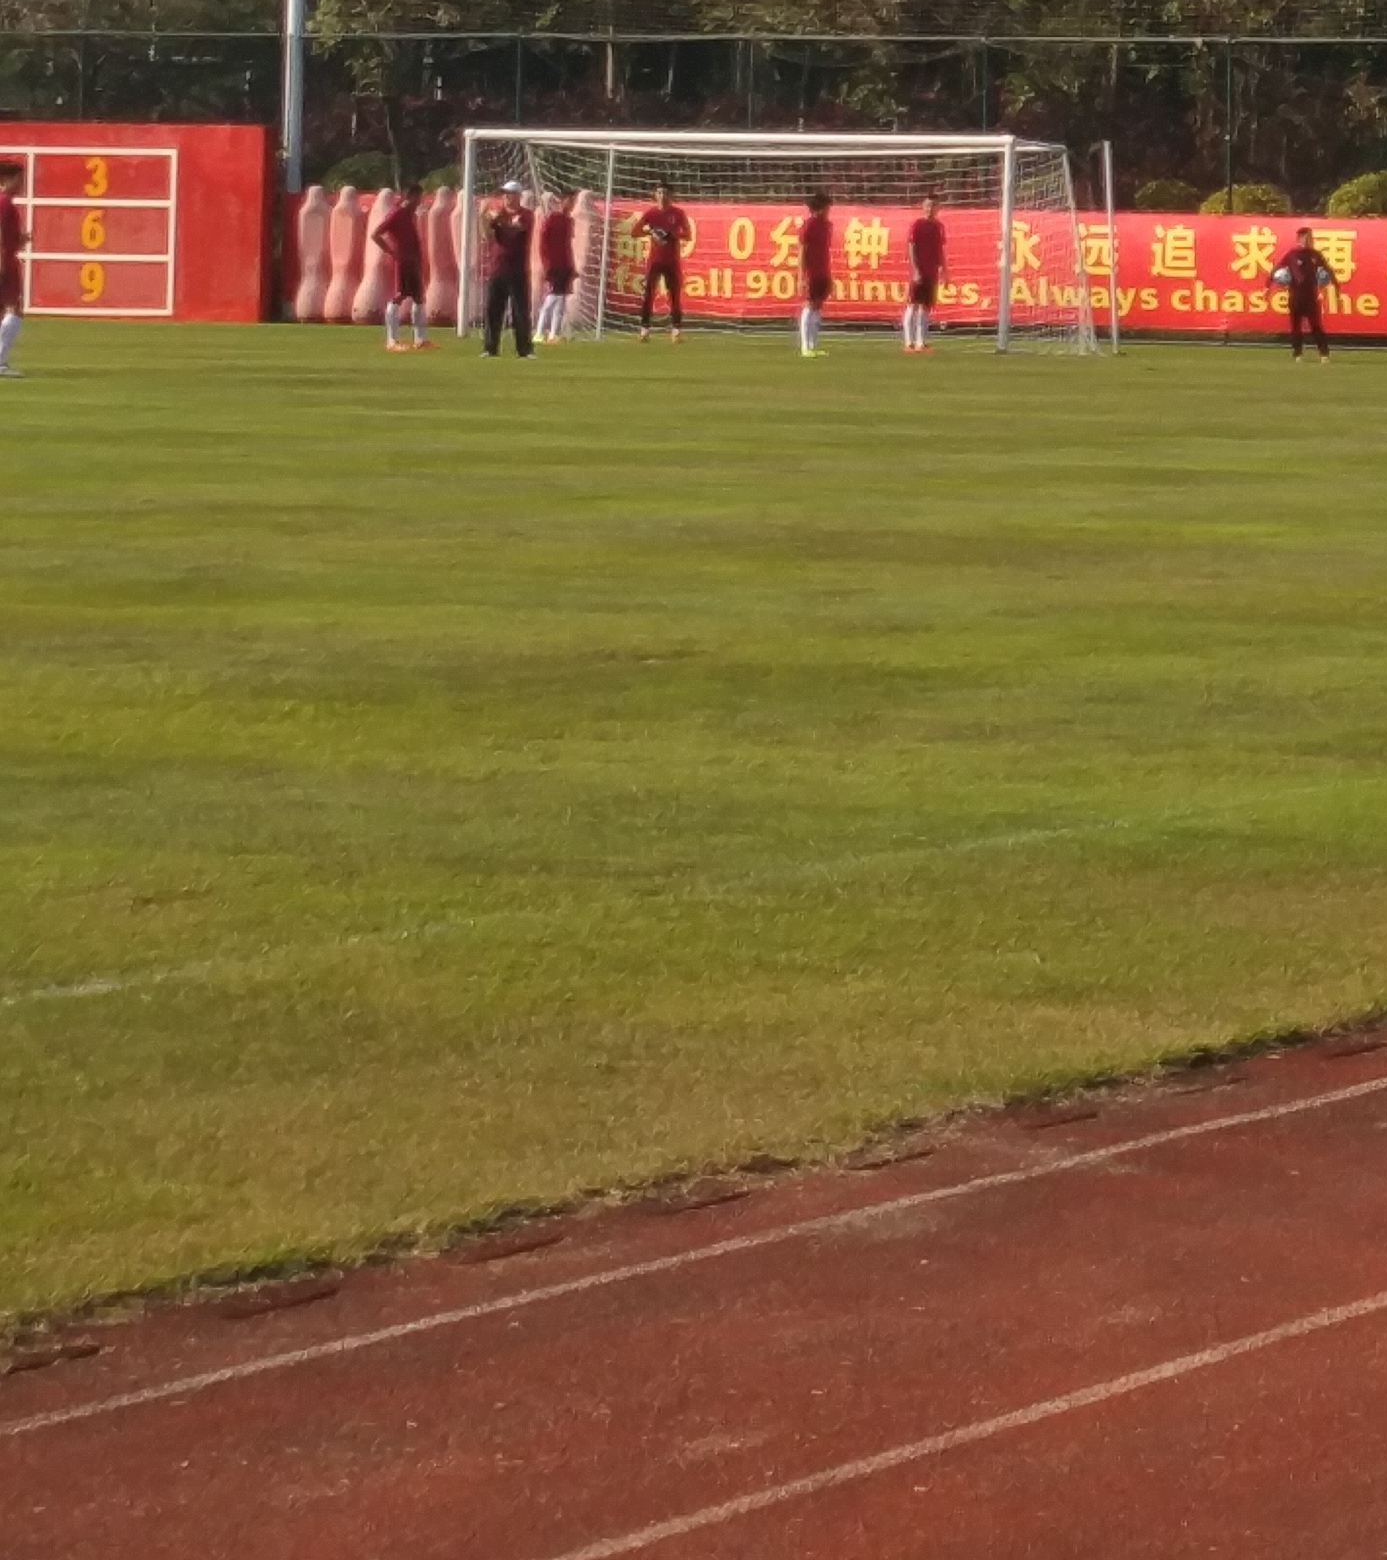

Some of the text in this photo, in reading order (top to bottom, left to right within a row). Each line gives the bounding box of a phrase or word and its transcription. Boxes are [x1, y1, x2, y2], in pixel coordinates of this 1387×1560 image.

[83, 156, 109, 198] 3
[80, 208, 107, 250] 6
[79, 261, 105, 303] 9
[682, 266, 733, 300] all
[745, 268, 797, 302] 90
[1009, 274, 1160, 318] Always
[1169, 279, 1292, 315] chase
